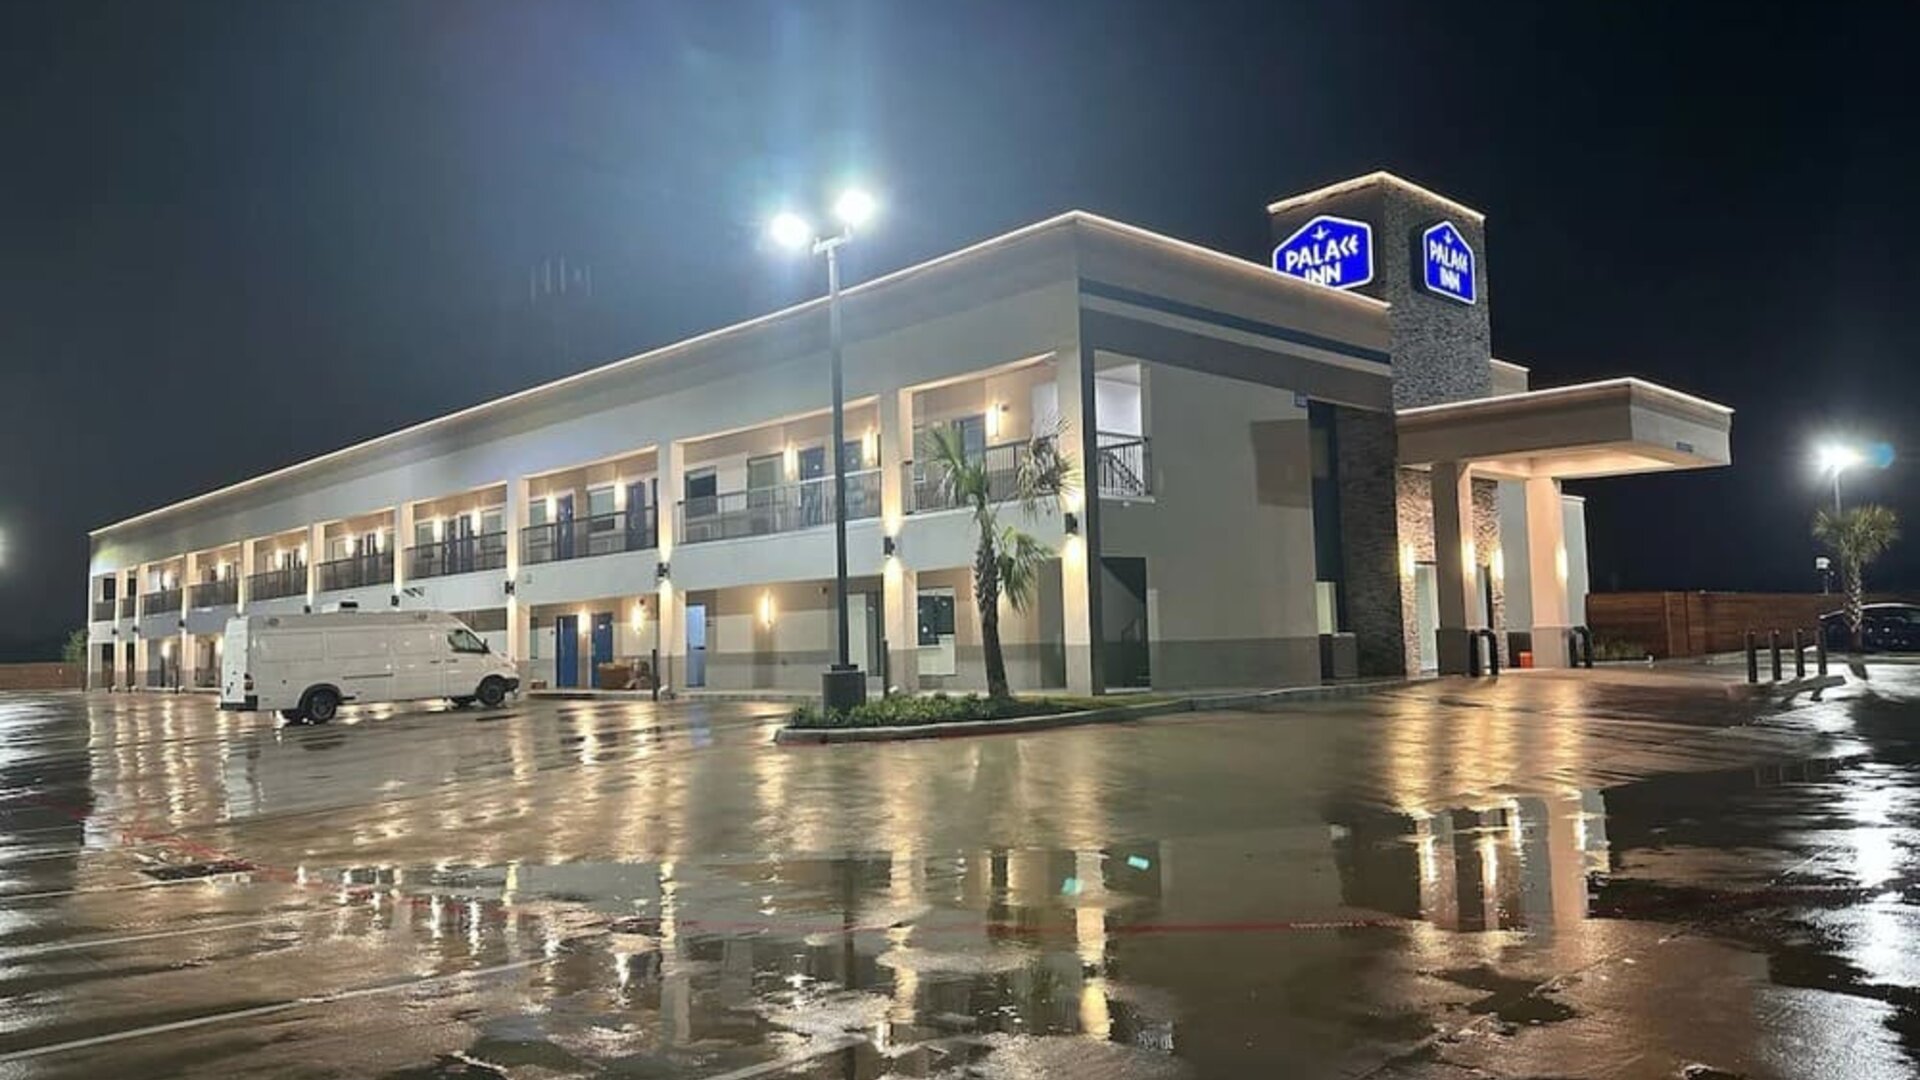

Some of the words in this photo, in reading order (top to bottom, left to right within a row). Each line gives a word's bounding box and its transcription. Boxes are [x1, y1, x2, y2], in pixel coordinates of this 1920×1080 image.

[1285, 234, 1358, 271] PALACE
[1429, 239, 1468, 275] PALACE
[1305, 262, 1341, 285] INN
[1440, 266, 1460, 292] INN
